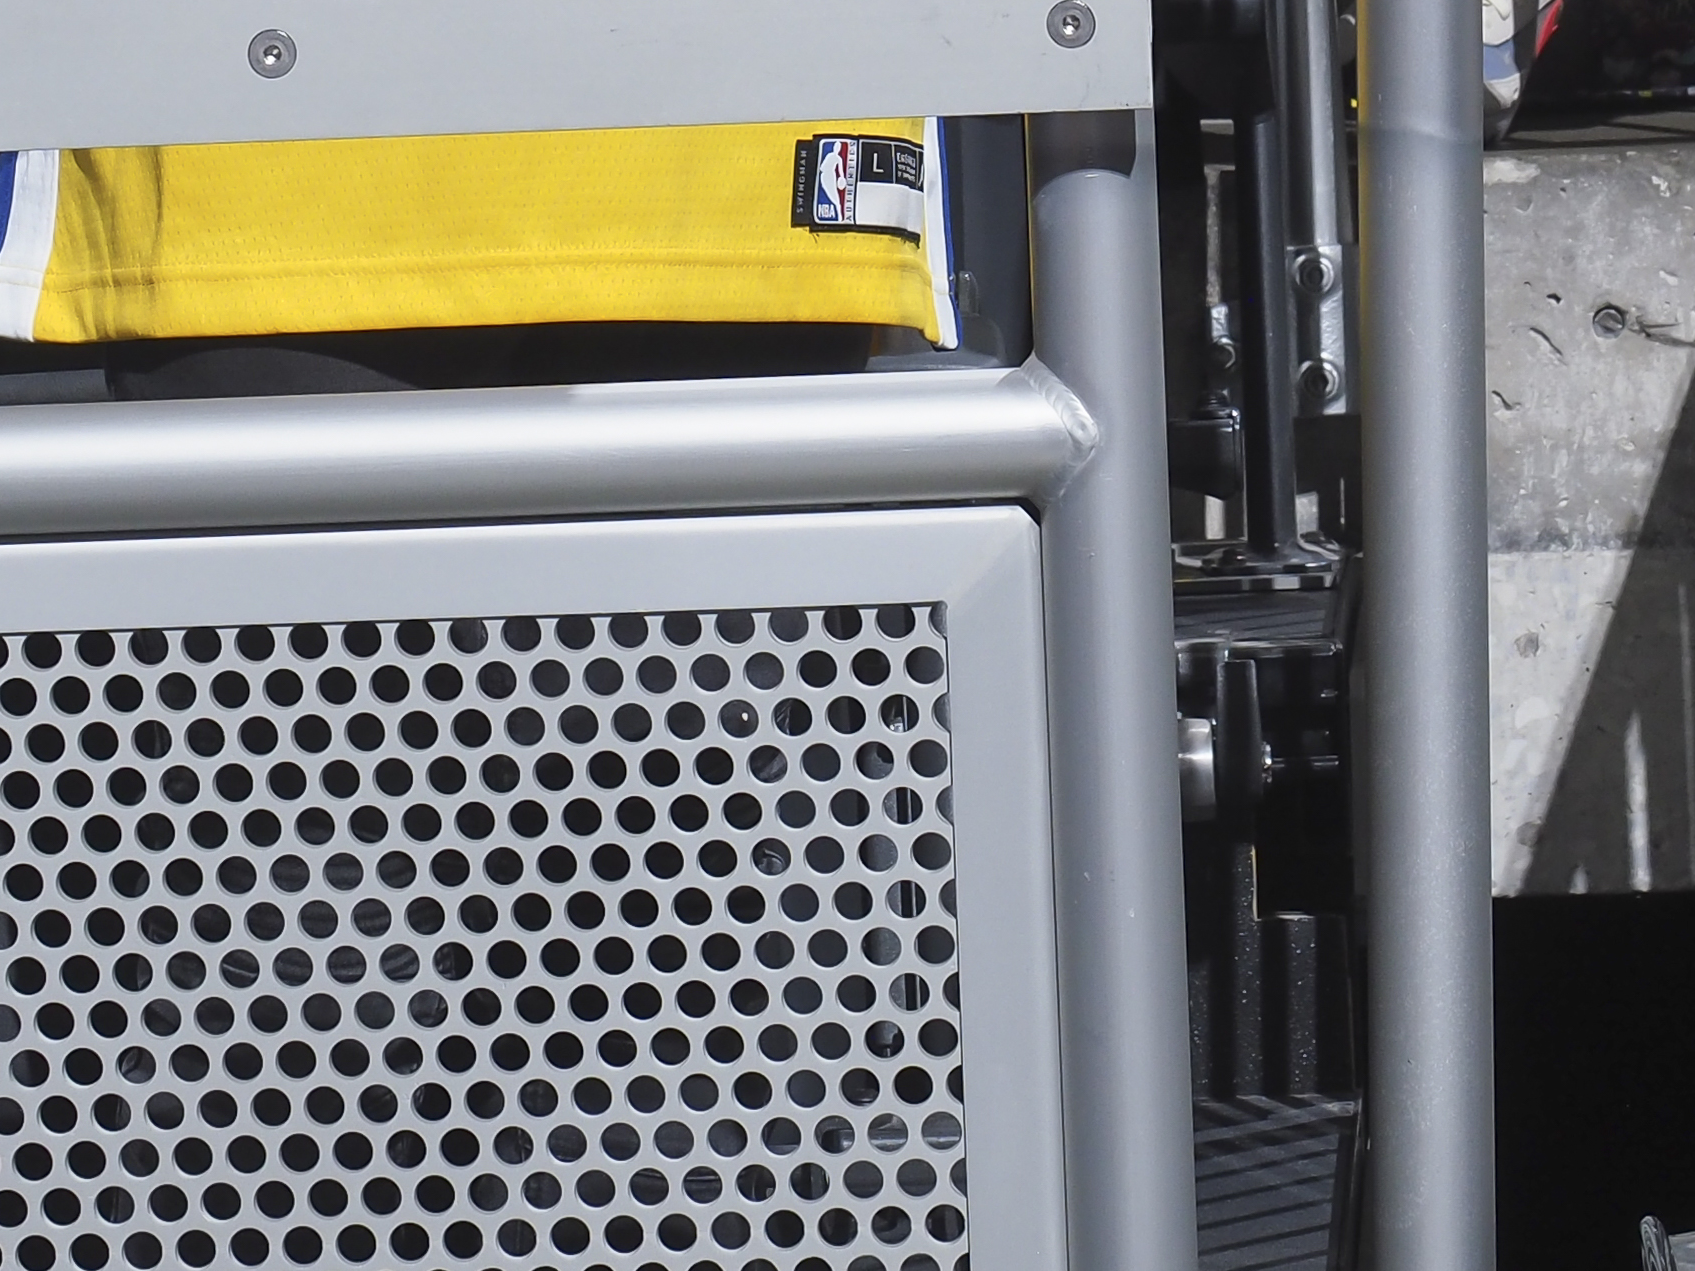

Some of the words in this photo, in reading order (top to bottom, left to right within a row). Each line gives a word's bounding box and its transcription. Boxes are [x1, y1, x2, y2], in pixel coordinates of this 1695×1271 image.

[872, 152, 885, 173] L
[796, 149, 808, 214] SWINGMAN
[817, 203, 836, 219] NBA
